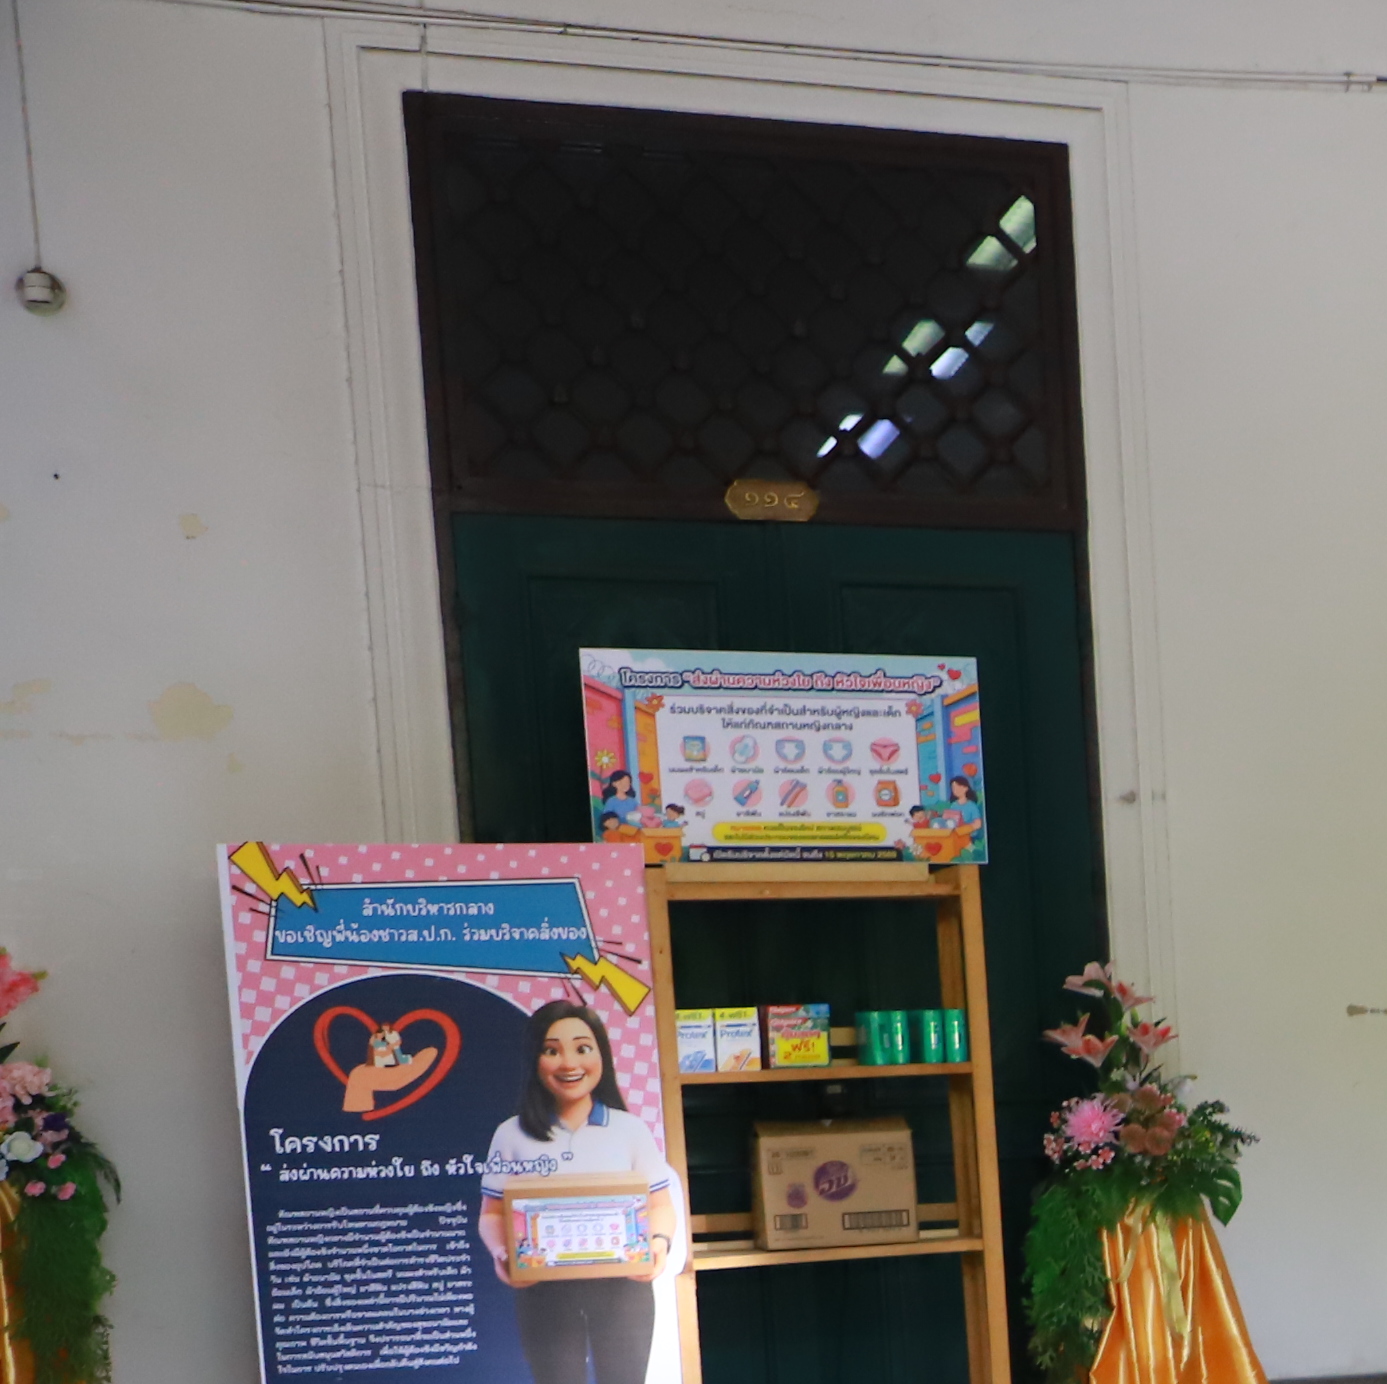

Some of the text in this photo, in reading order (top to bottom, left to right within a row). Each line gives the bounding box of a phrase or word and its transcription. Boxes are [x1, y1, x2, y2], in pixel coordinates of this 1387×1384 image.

[620, 669, 682, 687] โครงการ
[361, 897, 495, 917] สำนักบริหารกลาง
[274, 917, 588, 949] ขอเชิญพี่น้องชาวส.ป.ก. ร่วมบริจาคสิ่งของ
[719, 1028, 752, 1039] Protex
[269, 1128, 380, 1155] โครงการ
[278, 1156, 415, 1183] ส่งผ่านความห่วงใย
[420, 1161, 441, 1177] ถึง
[444, 1151, 559, 1179] หัวใจเพื่อนหญิง
